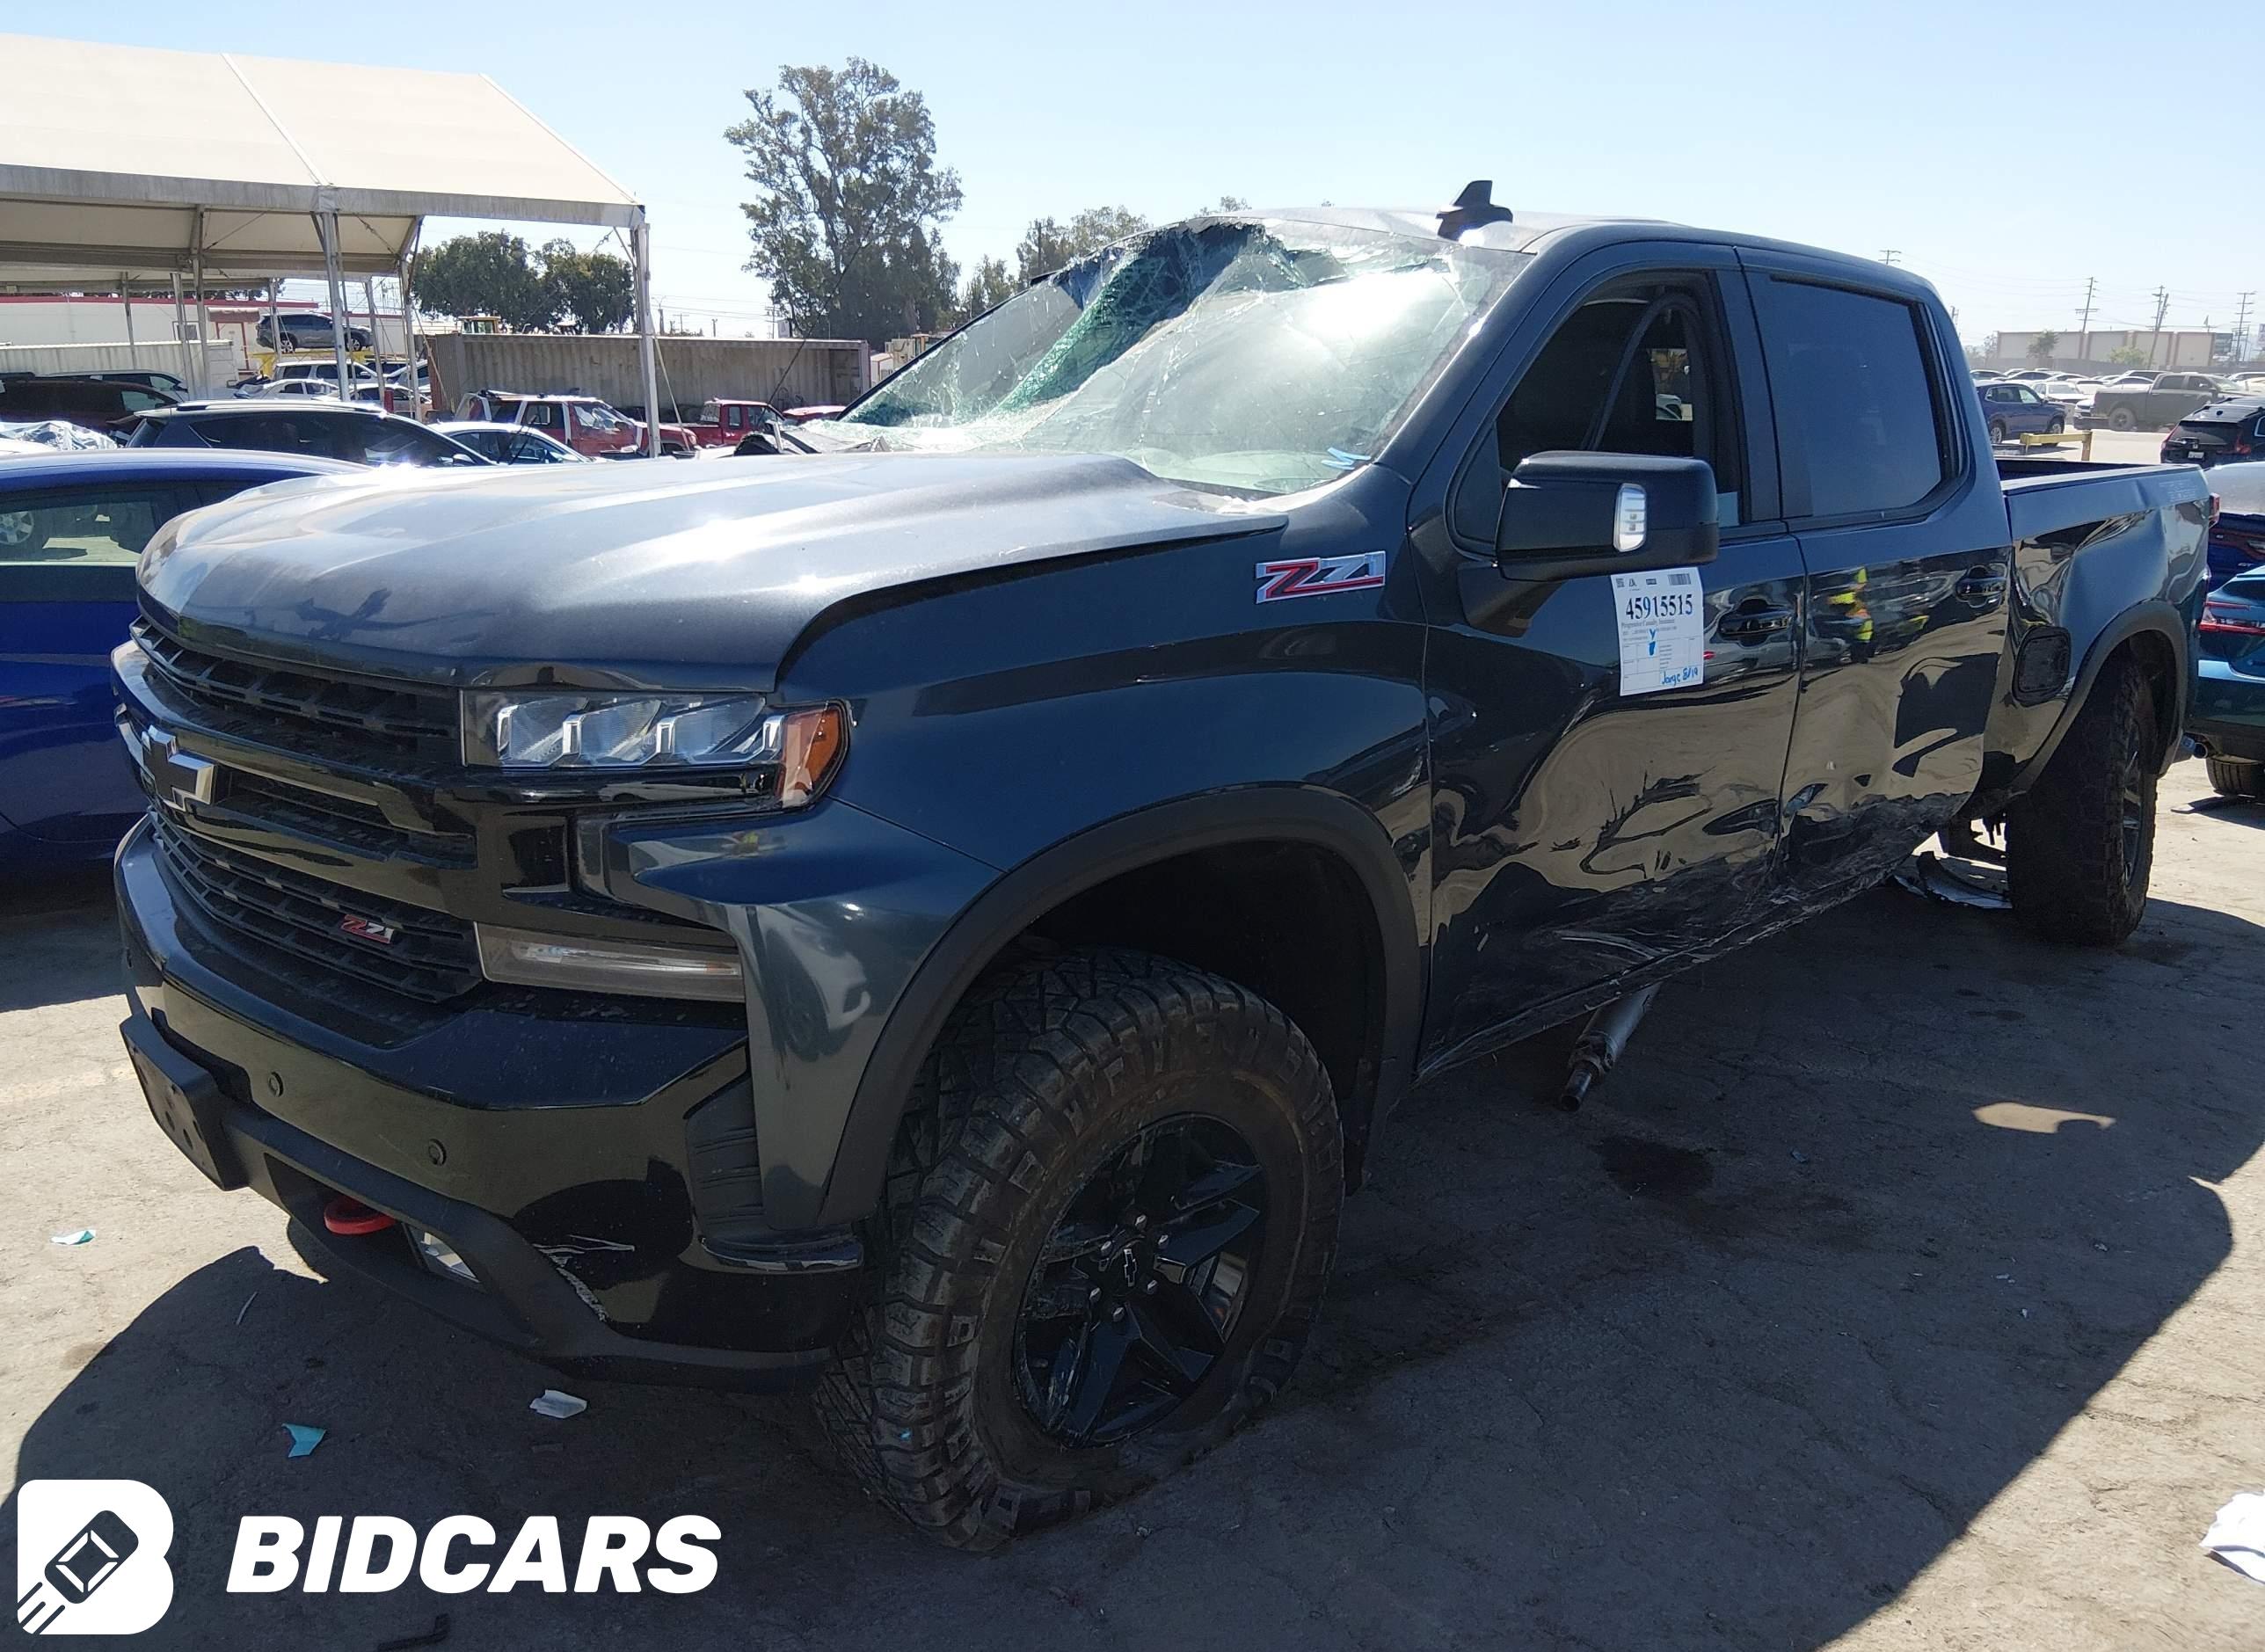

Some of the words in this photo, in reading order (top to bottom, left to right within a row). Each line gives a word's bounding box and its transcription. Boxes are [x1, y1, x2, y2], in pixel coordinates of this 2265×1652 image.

[1255, 550, 1387, 604] Z71
[1626, 593, 1693, 620] 45915515
[340, 914, 394, 944] Z71
